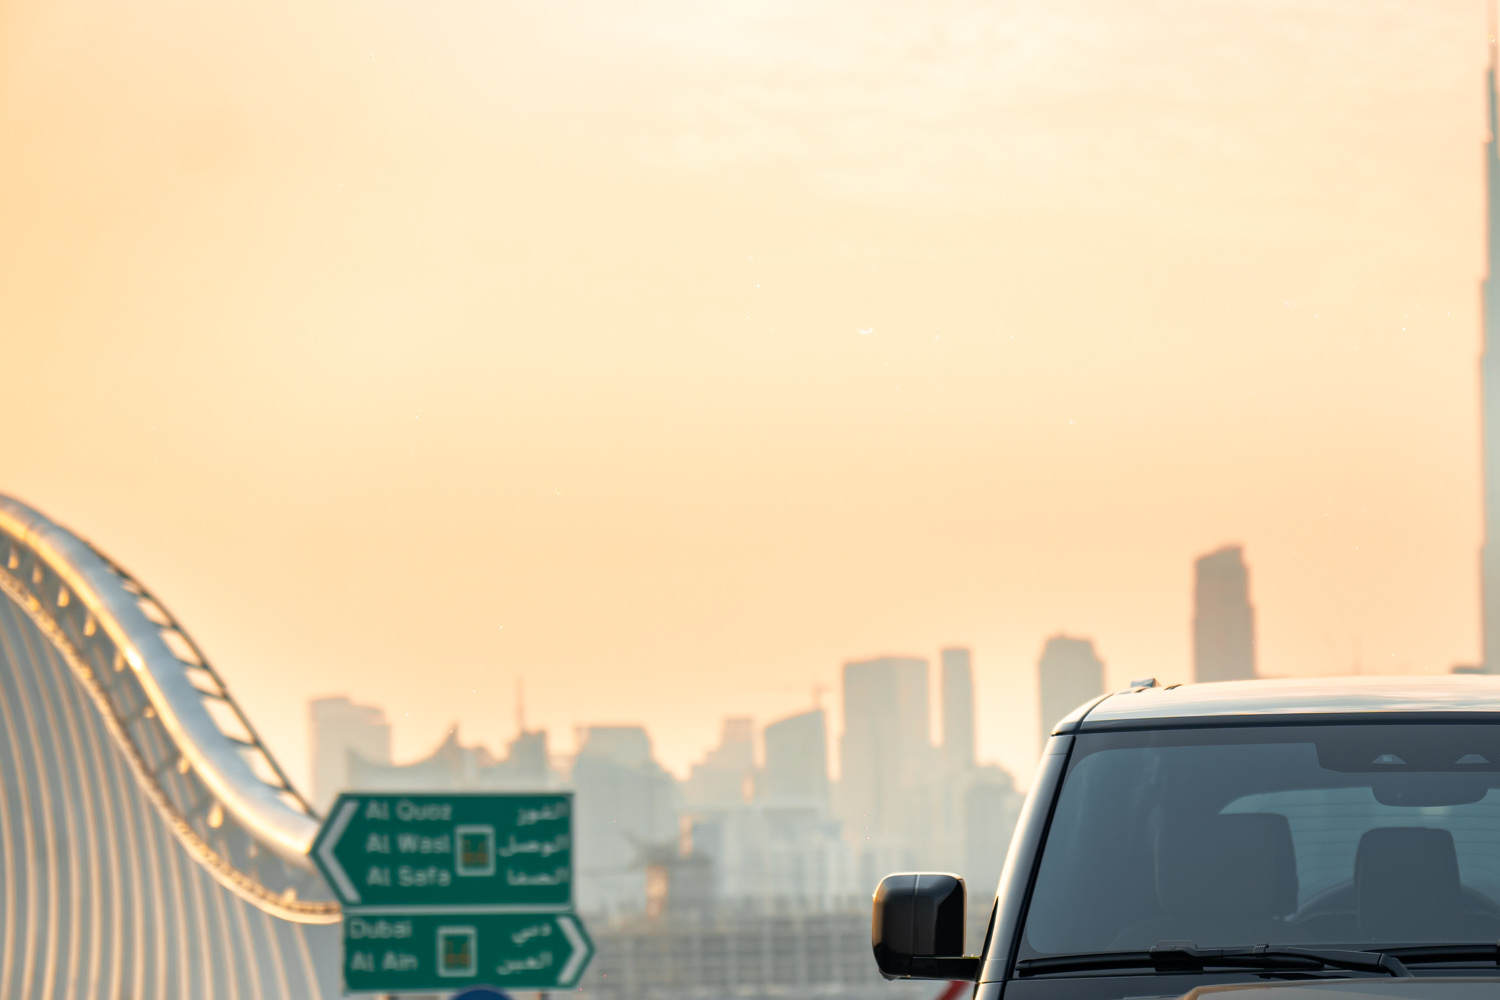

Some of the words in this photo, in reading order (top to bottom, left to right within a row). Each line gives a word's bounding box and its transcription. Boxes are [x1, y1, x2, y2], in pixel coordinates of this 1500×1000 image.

[366, 800, 390, 820] Al
[396, 801, 453, 821] Quoz
[367, 832, 391, 853] Al
[397, 832, 450, 853] Wasl
[367, 865, 391, 886] Al
[398, 865, 451, 886] Safa
[350, 919, 412, 939] Dubai
[351, 951, 375, 972] Al
[382, 951, 418, 971] Ain
